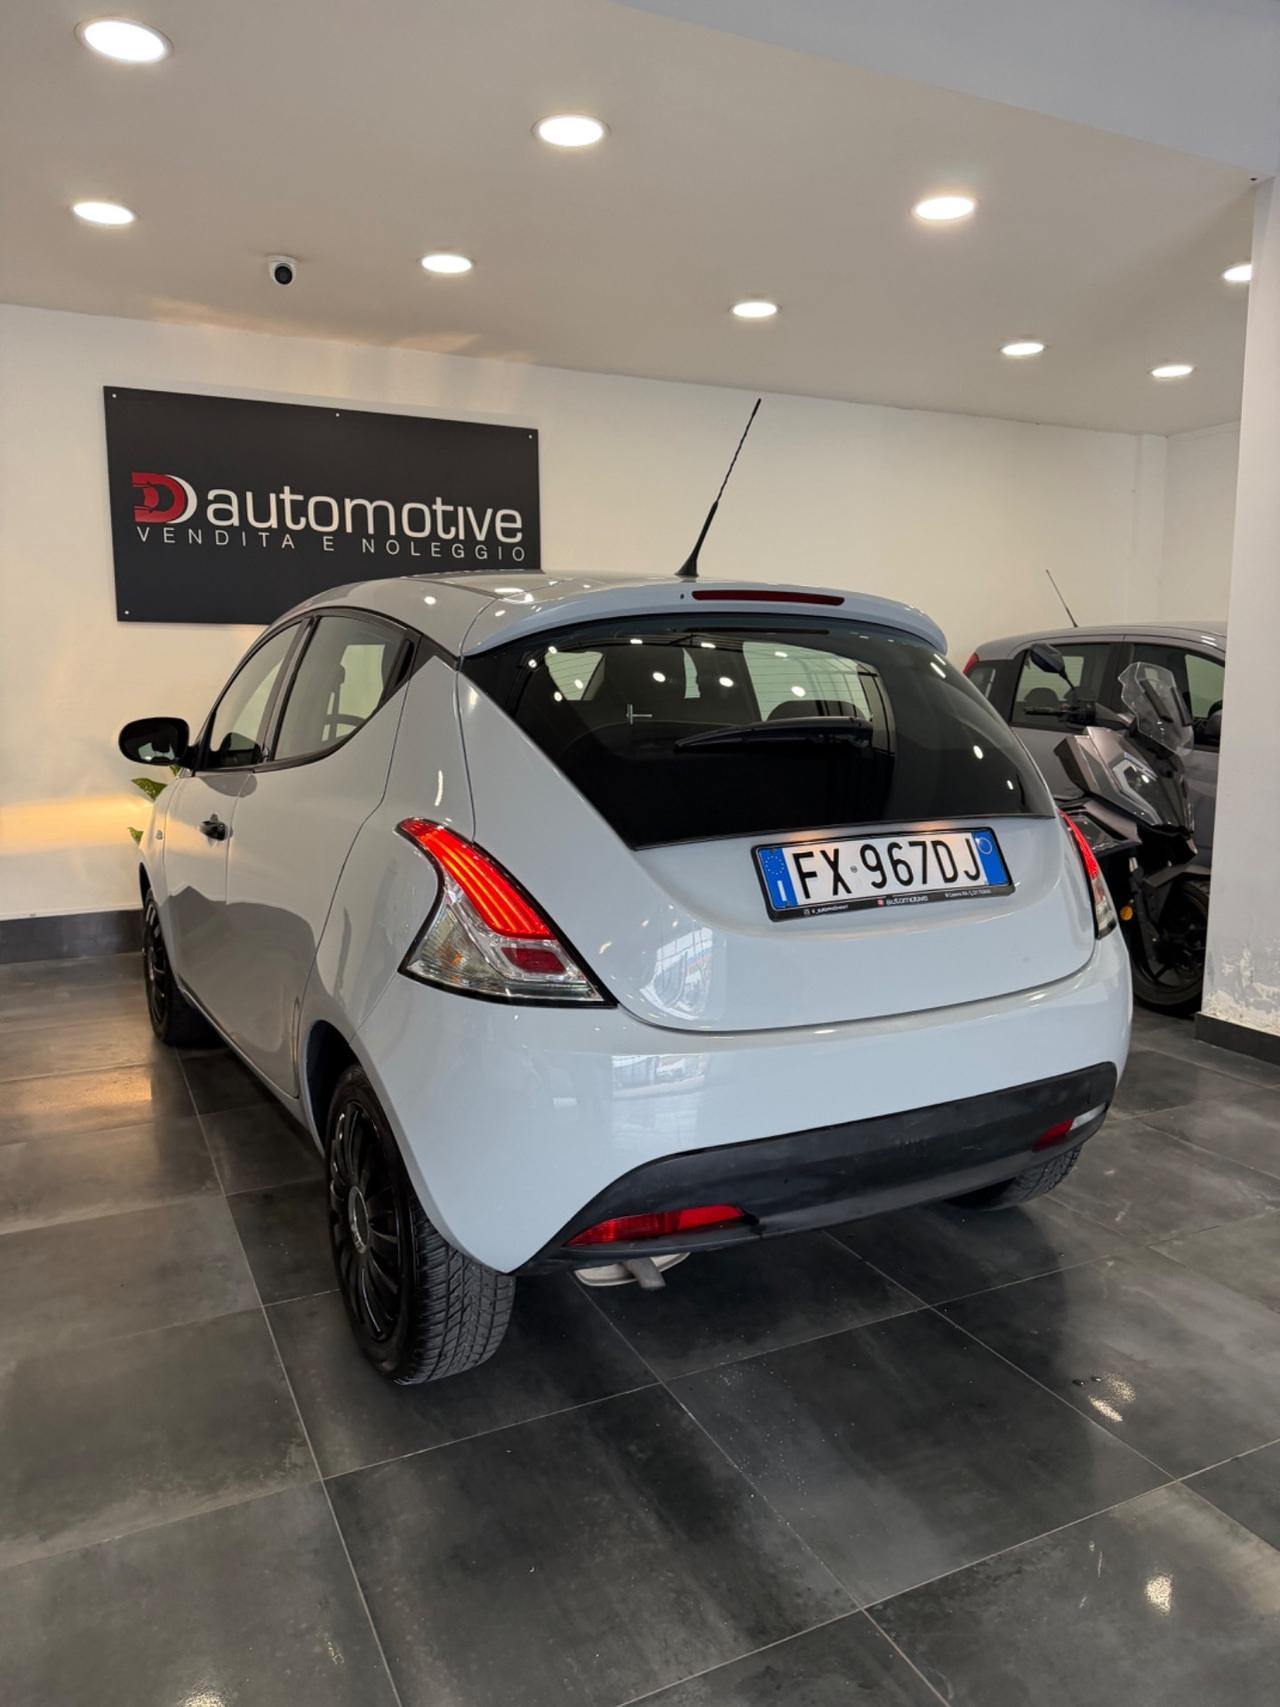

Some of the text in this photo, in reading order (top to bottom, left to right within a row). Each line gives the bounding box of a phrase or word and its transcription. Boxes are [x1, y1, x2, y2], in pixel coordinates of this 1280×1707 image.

[206, 486, 523, 543] automotive
[137, 526, 526, 563] VENDITA E NOLEGGIO
[792, 848, 853, 899] FX
[859, 838, 981, 889] 967DJ
